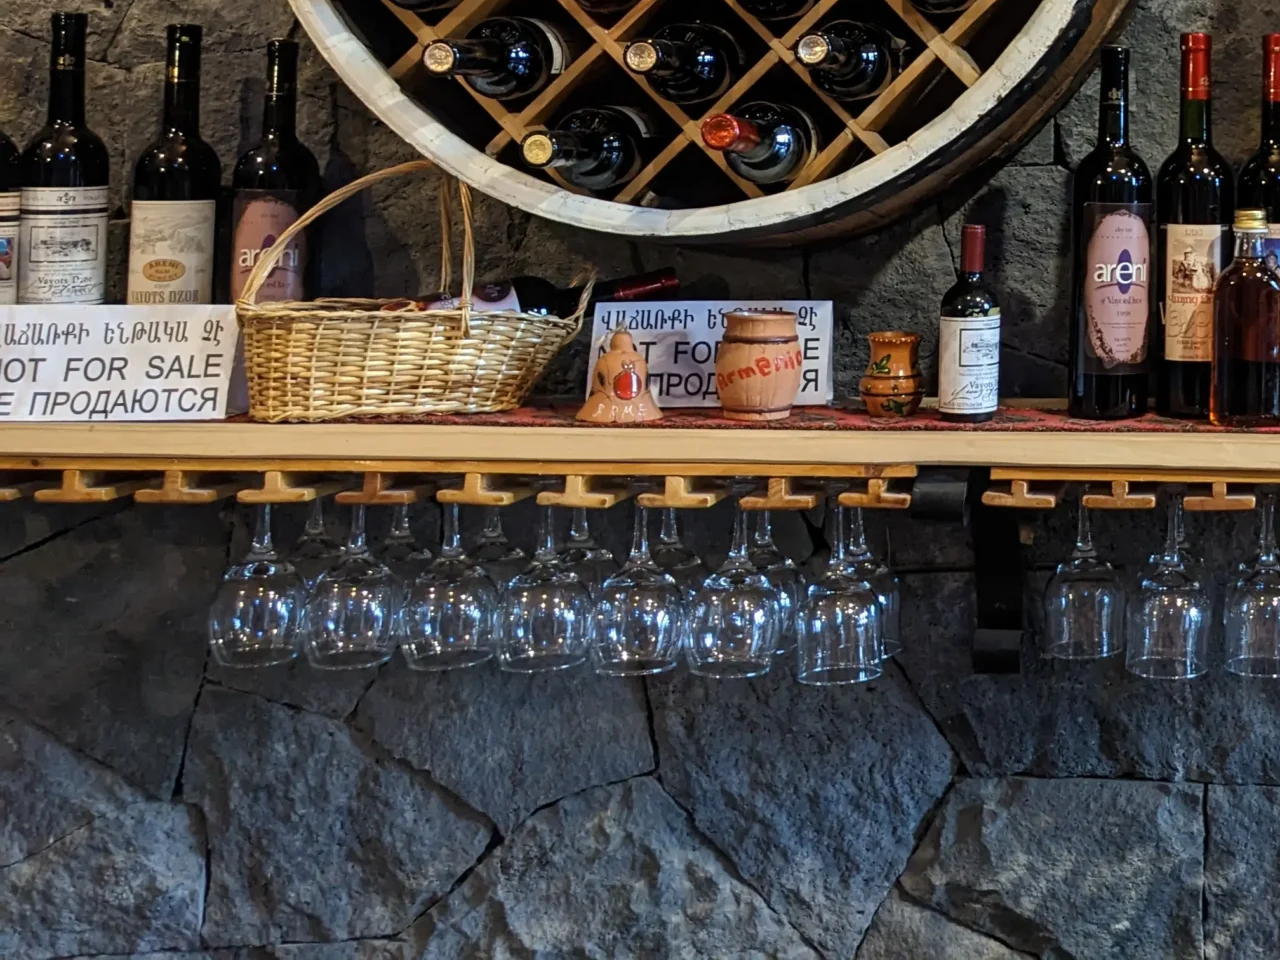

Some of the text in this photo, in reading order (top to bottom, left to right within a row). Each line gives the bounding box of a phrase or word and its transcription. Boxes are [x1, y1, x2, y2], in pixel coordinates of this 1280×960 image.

[1093, 257, 1147, 285] areni
[0, 323, 90, 346] ԱՃԱՌՔԻ
[673, 340, 718, 364] FO
[0, 353, 224, 383] OT FOR SALE
[0, 387, 219, 419] Е ПРОДАЮТСЯ
